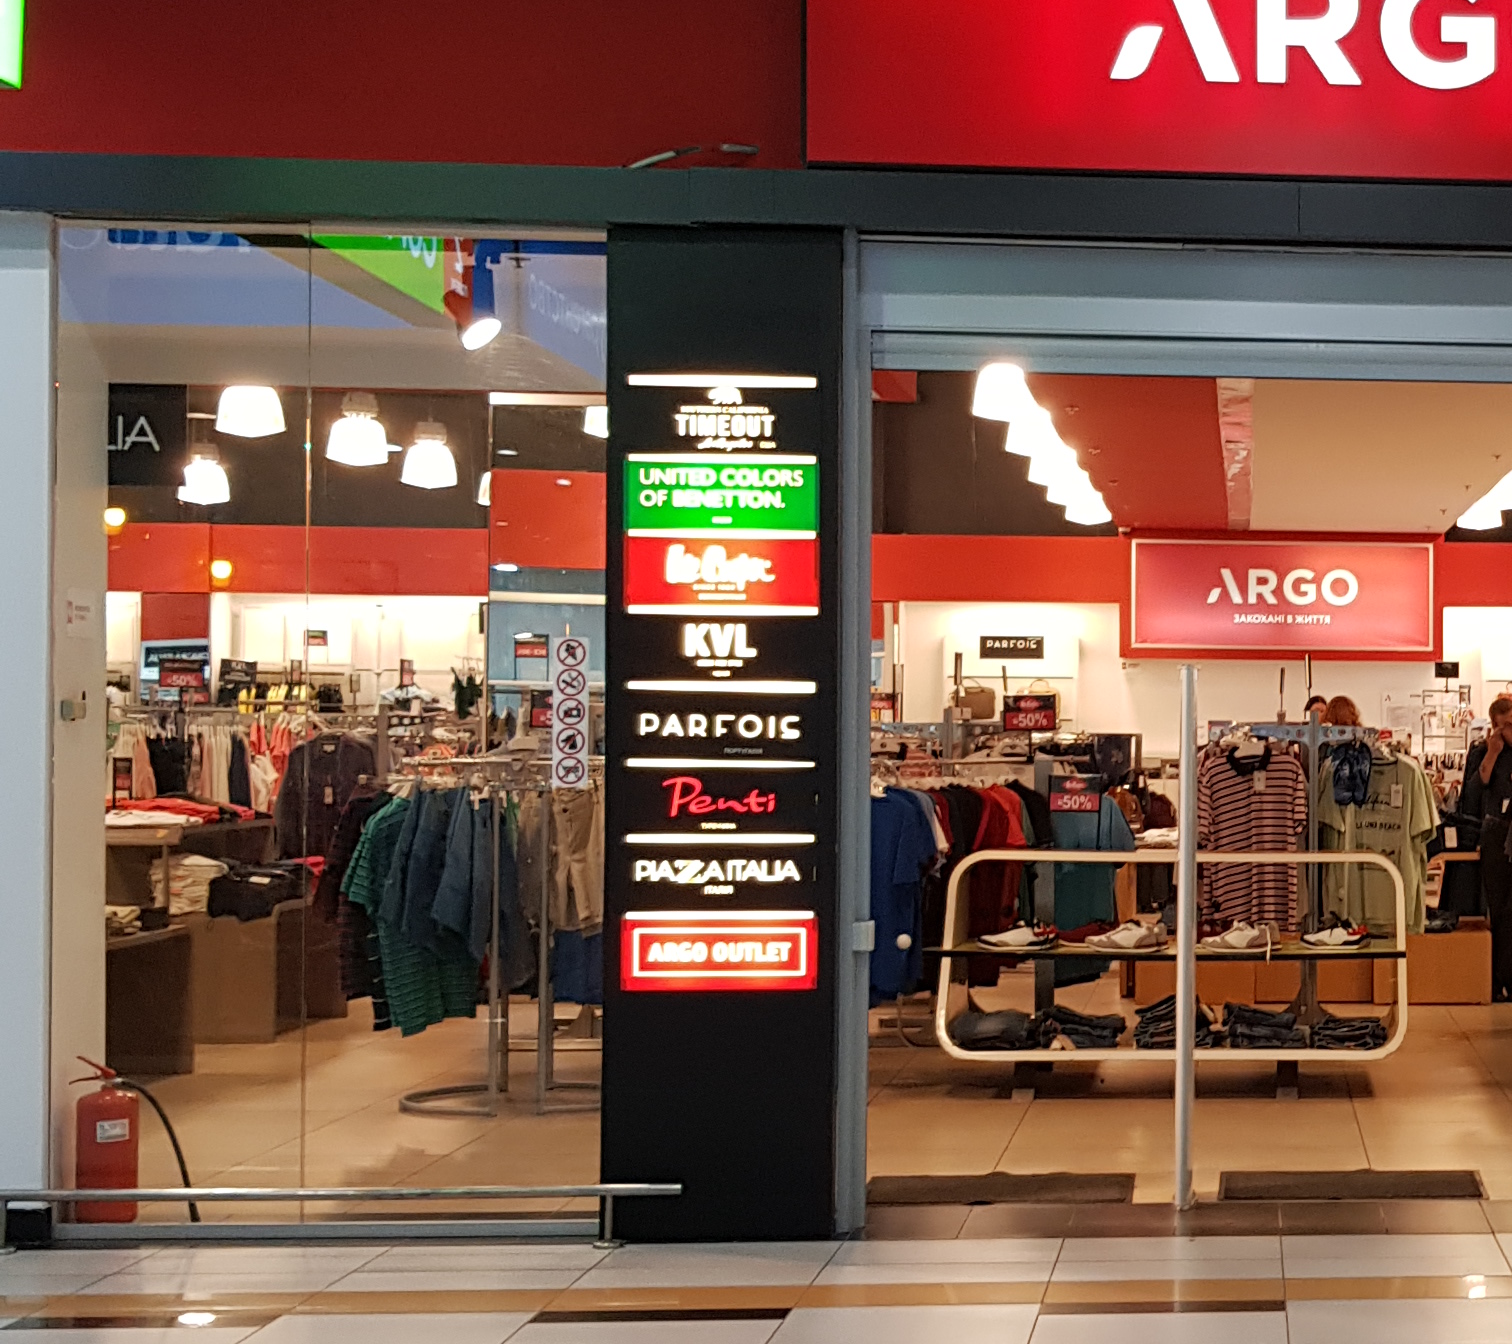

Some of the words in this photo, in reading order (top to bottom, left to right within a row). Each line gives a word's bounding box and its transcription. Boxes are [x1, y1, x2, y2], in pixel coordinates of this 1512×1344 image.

[675, 415, 775, 437] TIMEOUT
[640, 468, 717, 486] UNITED
[720, 469, 804, 487] COLORS
[640, 490, 668, 507] OF
[1207, 568, 1359, 606] ARGO
[1233, 613, 1285, 625] ЗАКОХАНІ
[1286, 614, 1293, 624] В
[1295, 614, 1331, 625] ЖИТТЯ
[684, 623, 757, 657] KVL
[639, 713, 801, 739] PARFOIS
[662, 777, 776, 817] Penti
[647, 942, 708, 962] ARGO
[712, 942, 792, 962] OUTLET
